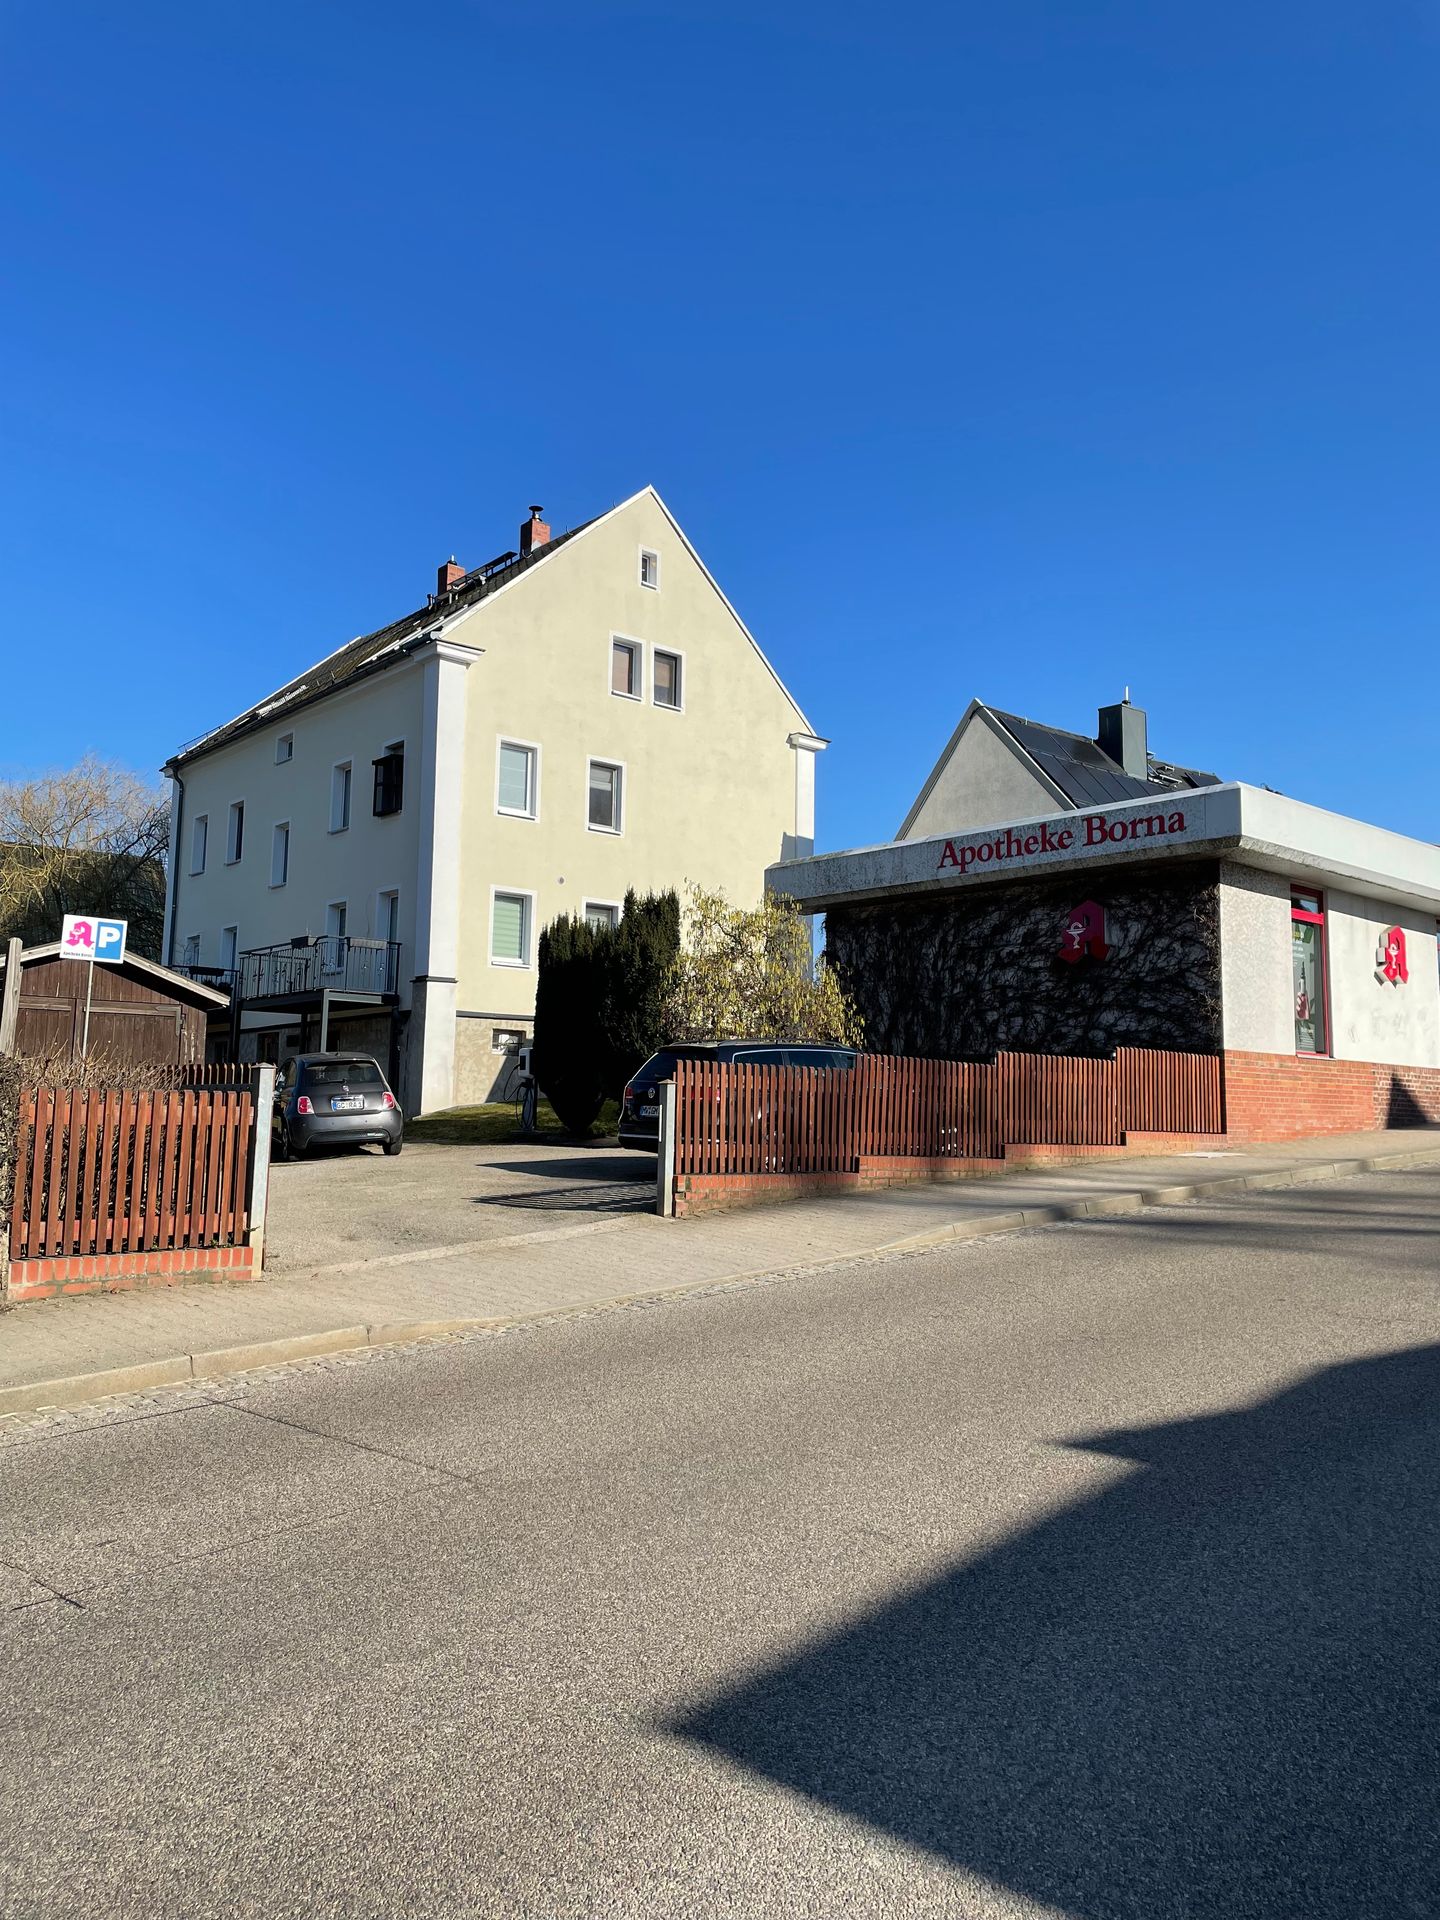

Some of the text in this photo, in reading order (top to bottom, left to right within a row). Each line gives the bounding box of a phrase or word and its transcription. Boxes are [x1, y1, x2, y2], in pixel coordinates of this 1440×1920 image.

[937, 811, 1187, 875] Apotheke Borna
[98, 926, 121, 949] P
